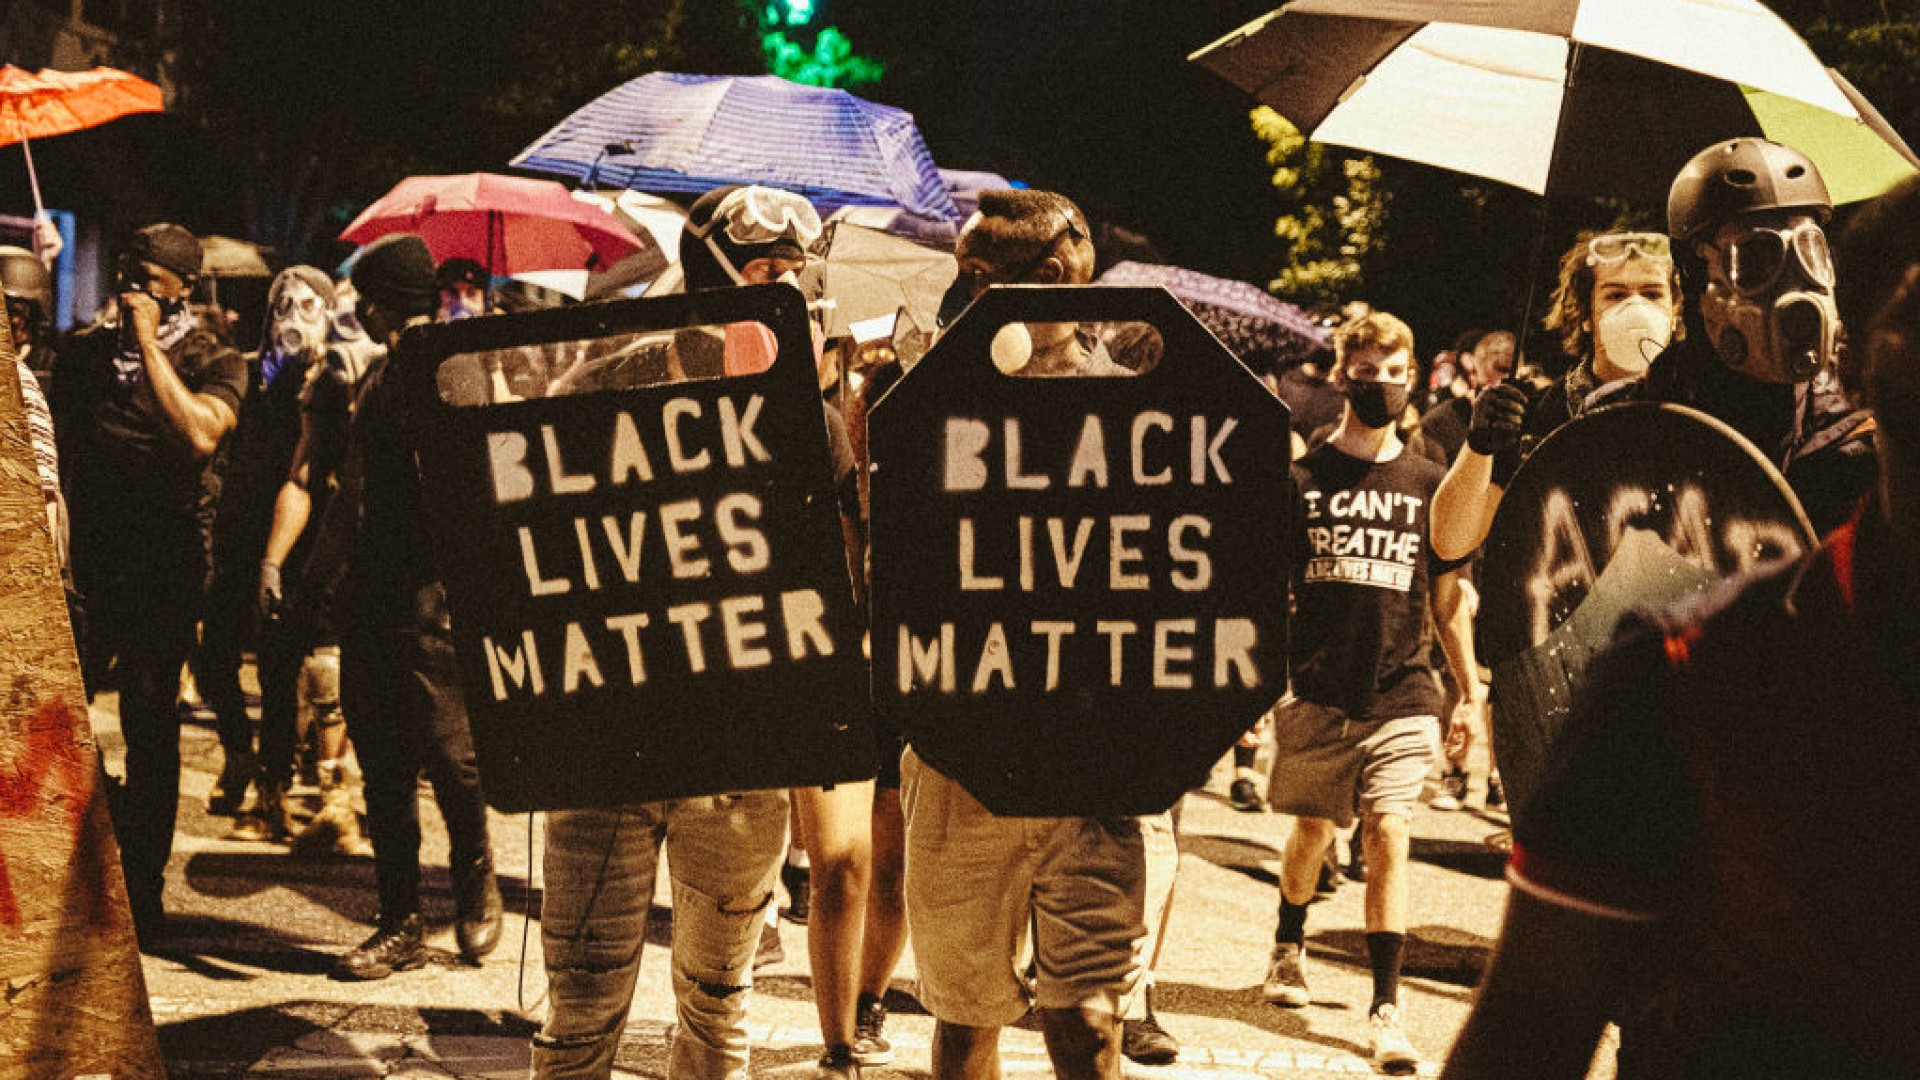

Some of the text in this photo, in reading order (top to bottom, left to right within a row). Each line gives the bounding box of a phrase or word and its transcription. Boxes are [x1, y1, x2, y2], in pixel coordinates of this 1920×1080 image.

[486, 393, 773, 503] BLACK
[943, 410, 1239, 492] BLACK
[518, 493, 772, 597] LIVES
[1304, 489, 1423, 524] I CAN'T
[1307, 525, 1421, 565] REATHE
[958, 514, 1213, 592] LIVES
[483, 589, 836, 701] MATTER
[897, 617, 1262, 694] MATTER
